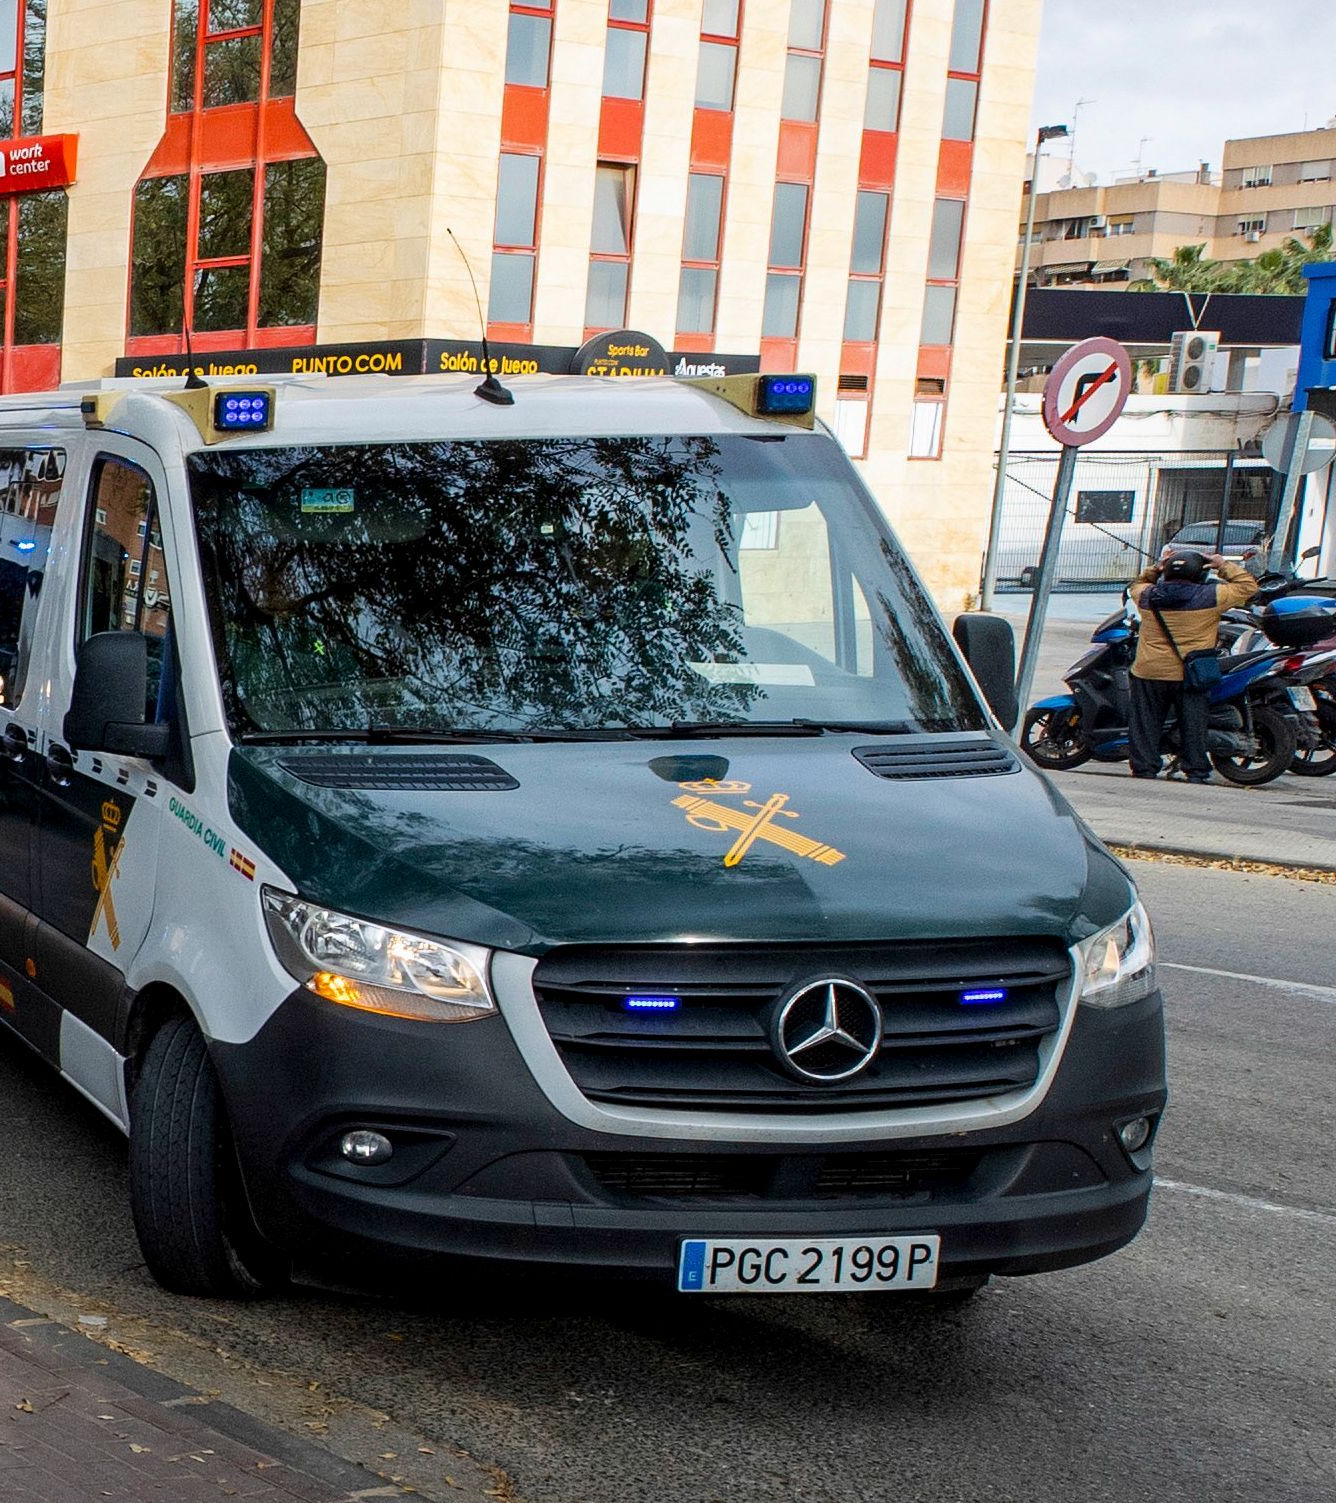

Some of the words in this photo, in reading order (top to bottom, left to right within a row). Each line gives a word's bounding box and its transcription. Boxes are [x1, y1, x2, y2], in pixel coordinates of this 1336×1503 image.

[9, 143, 43, 161] work
[10, 159, 51, 176] center
[440, 350, 477, 371] Salón
[480, 358, 498, 373] de
[607, 344, 634, 357] Sports
[635, 345, 650, 357] Bar
[292, 357, 352, 375] PUNTO
[355, 352, 403, 373] COM
[168, 797, 203, 838] GUARDIA
[203, 828, 227, 858] CIVIL
[688, 1270, 697, 1282] E
[709, 1247, 788, 1284] PGC
[796, 1245, 900, 1284] 2199
[906, 1243, 932, 1281] P
